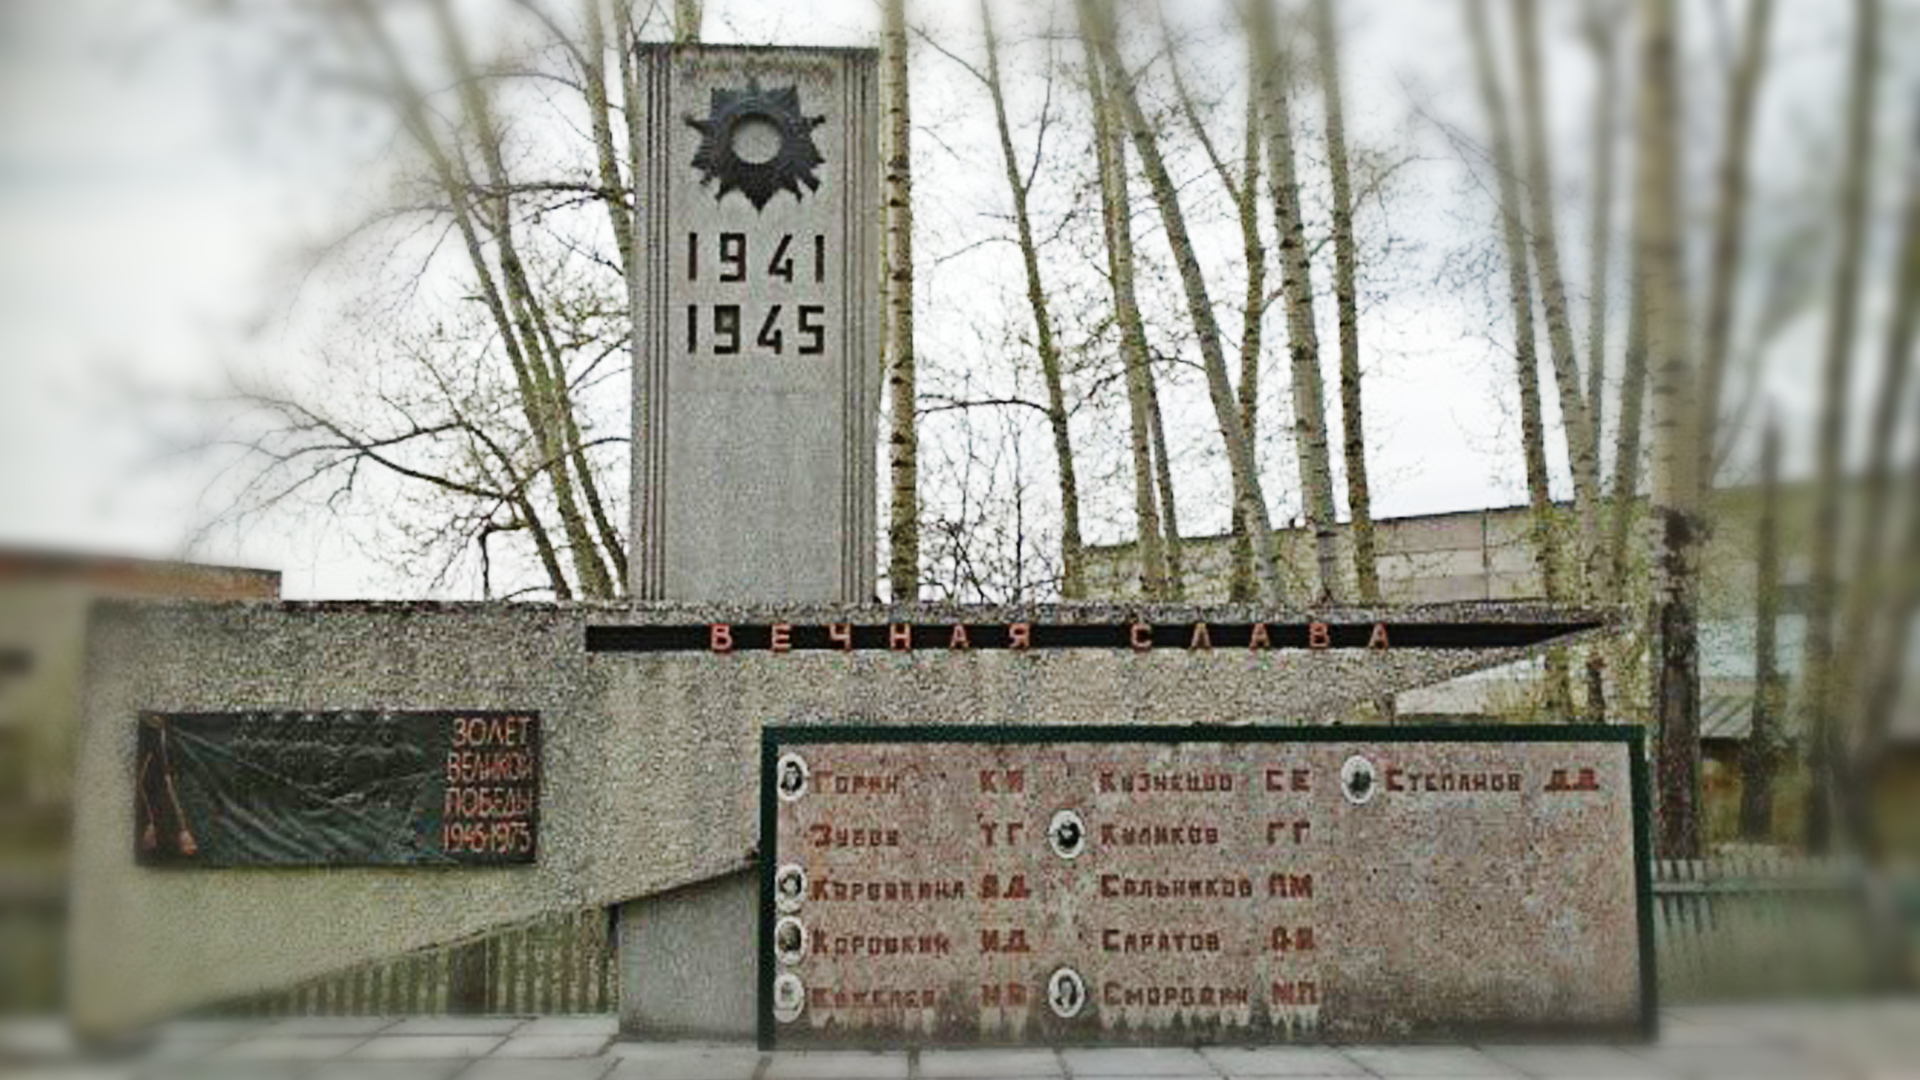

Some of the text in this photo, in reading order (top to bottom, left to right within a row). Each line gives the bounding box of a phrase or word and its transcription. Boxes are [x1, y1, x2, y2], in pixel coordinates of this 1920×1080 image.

[687, 231, 826, 283] 1941
[687, 304, 825, 354] 1945
[709, 622, 1391, 651] ВЕЧНАЯ СЛАВА
